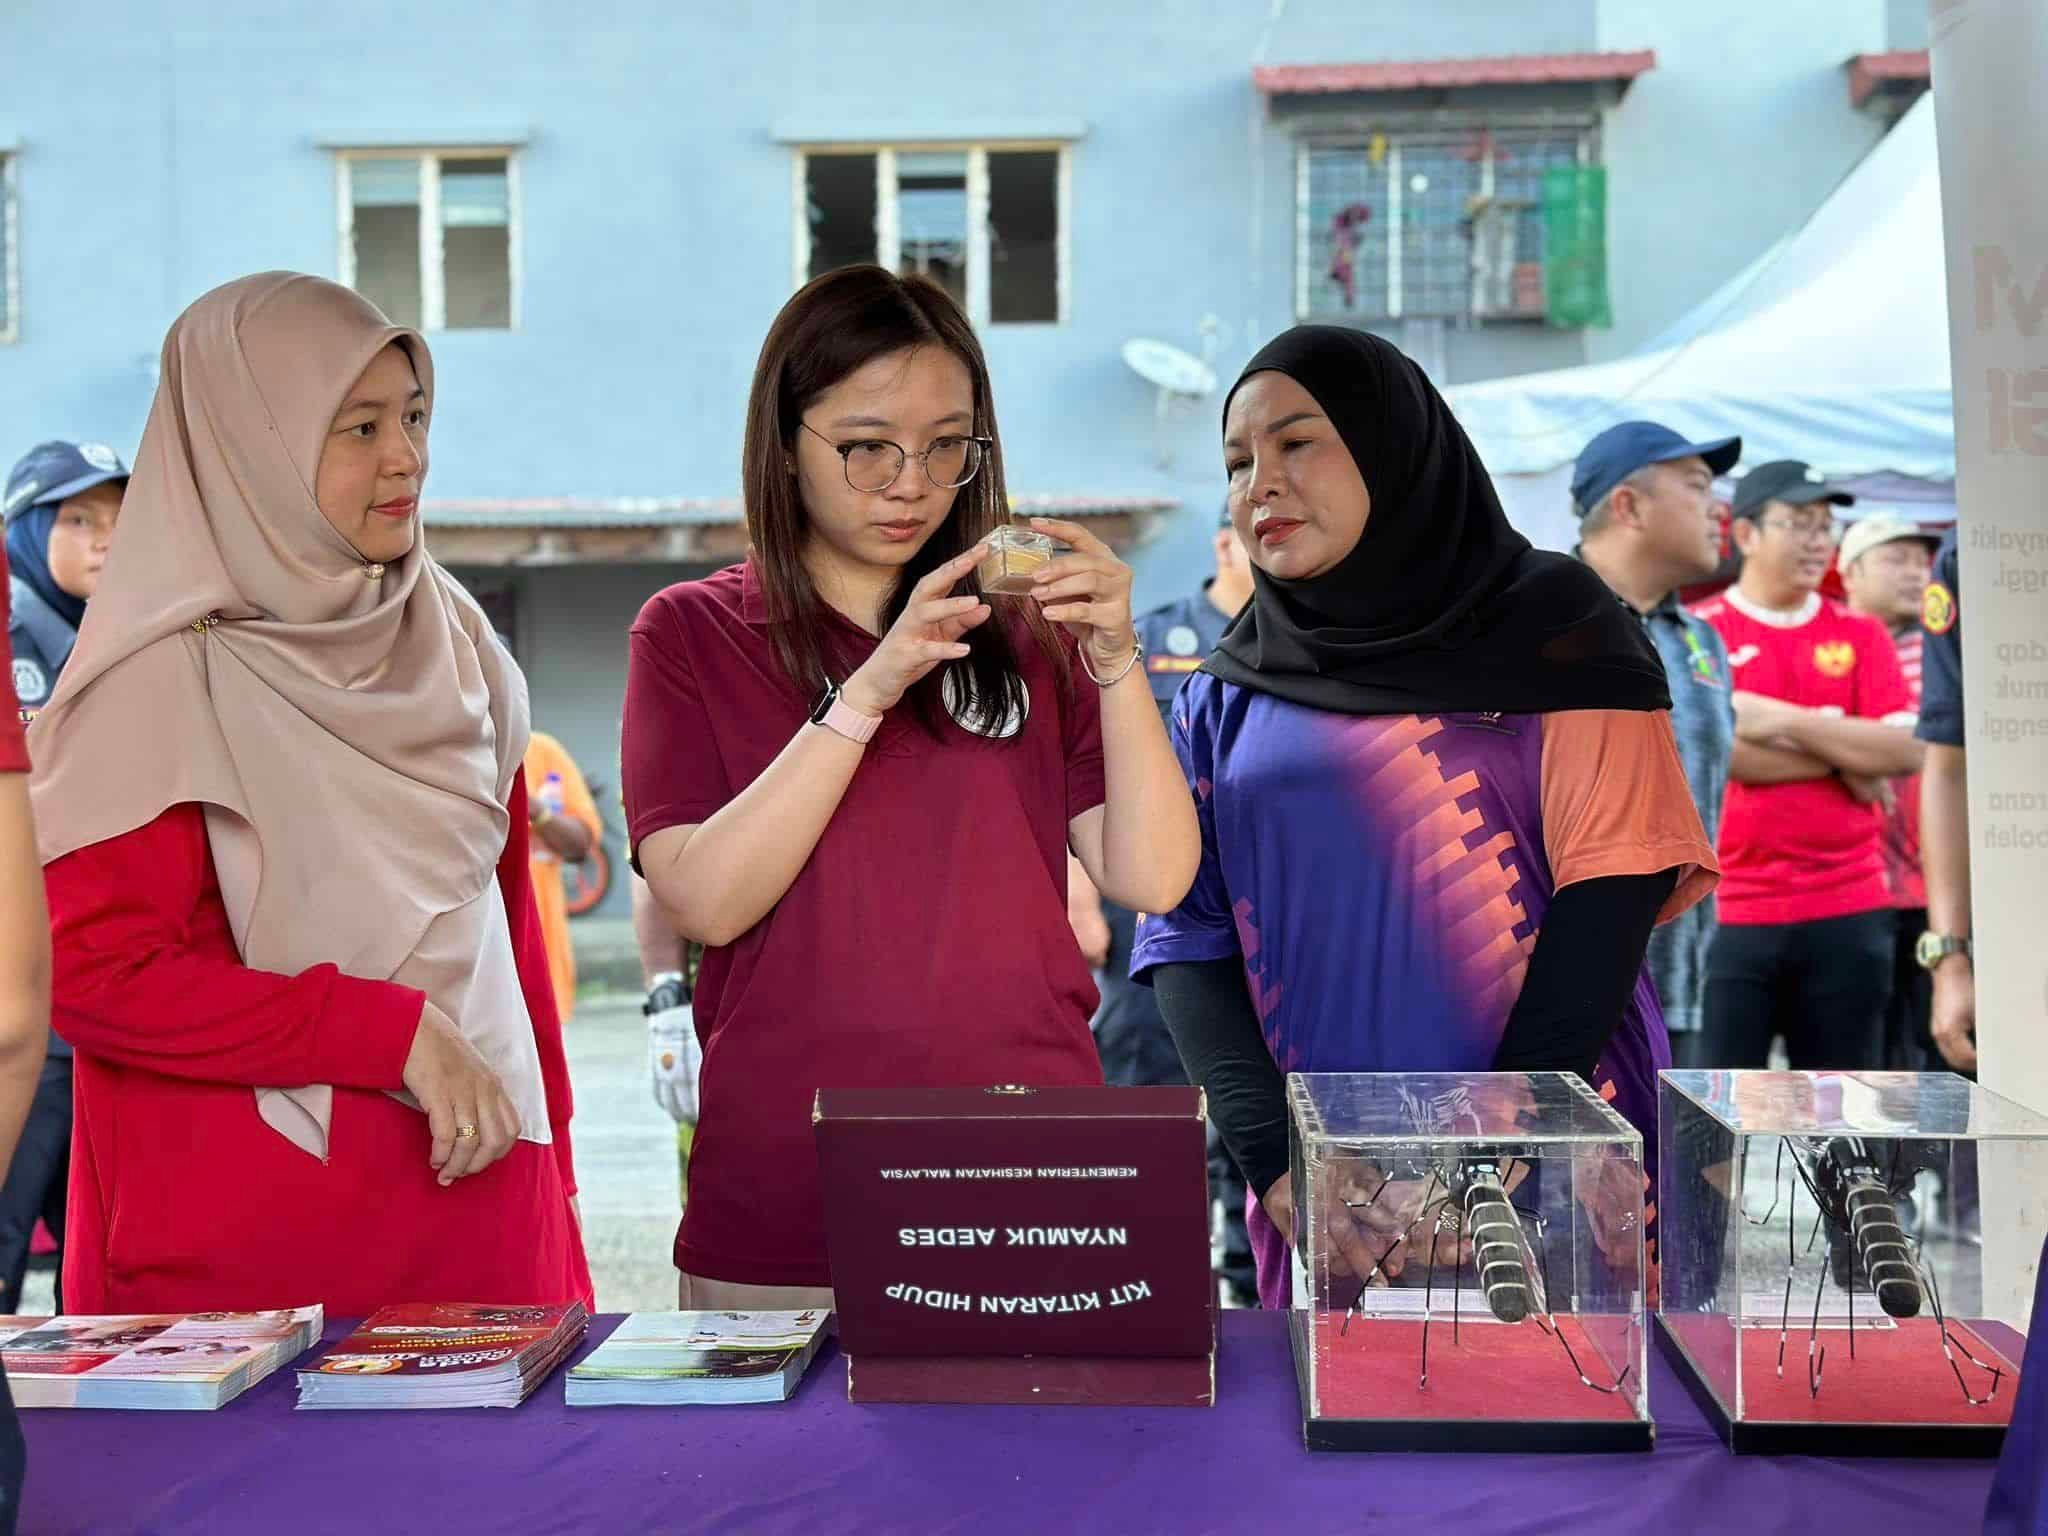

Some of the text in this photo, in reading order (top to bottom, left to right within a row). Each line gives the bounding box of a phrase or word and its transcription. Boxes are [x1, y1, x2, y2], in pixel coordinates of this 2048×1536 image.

[880, 1167, 1138, 1179] KEMENTERIAN KESIHATAN MALAYSIA
[898, 1227, 1127, 1246] NYAMUK AEDES
[885, 1280, 1152, 1314] KIT KITARAN HIDUP
